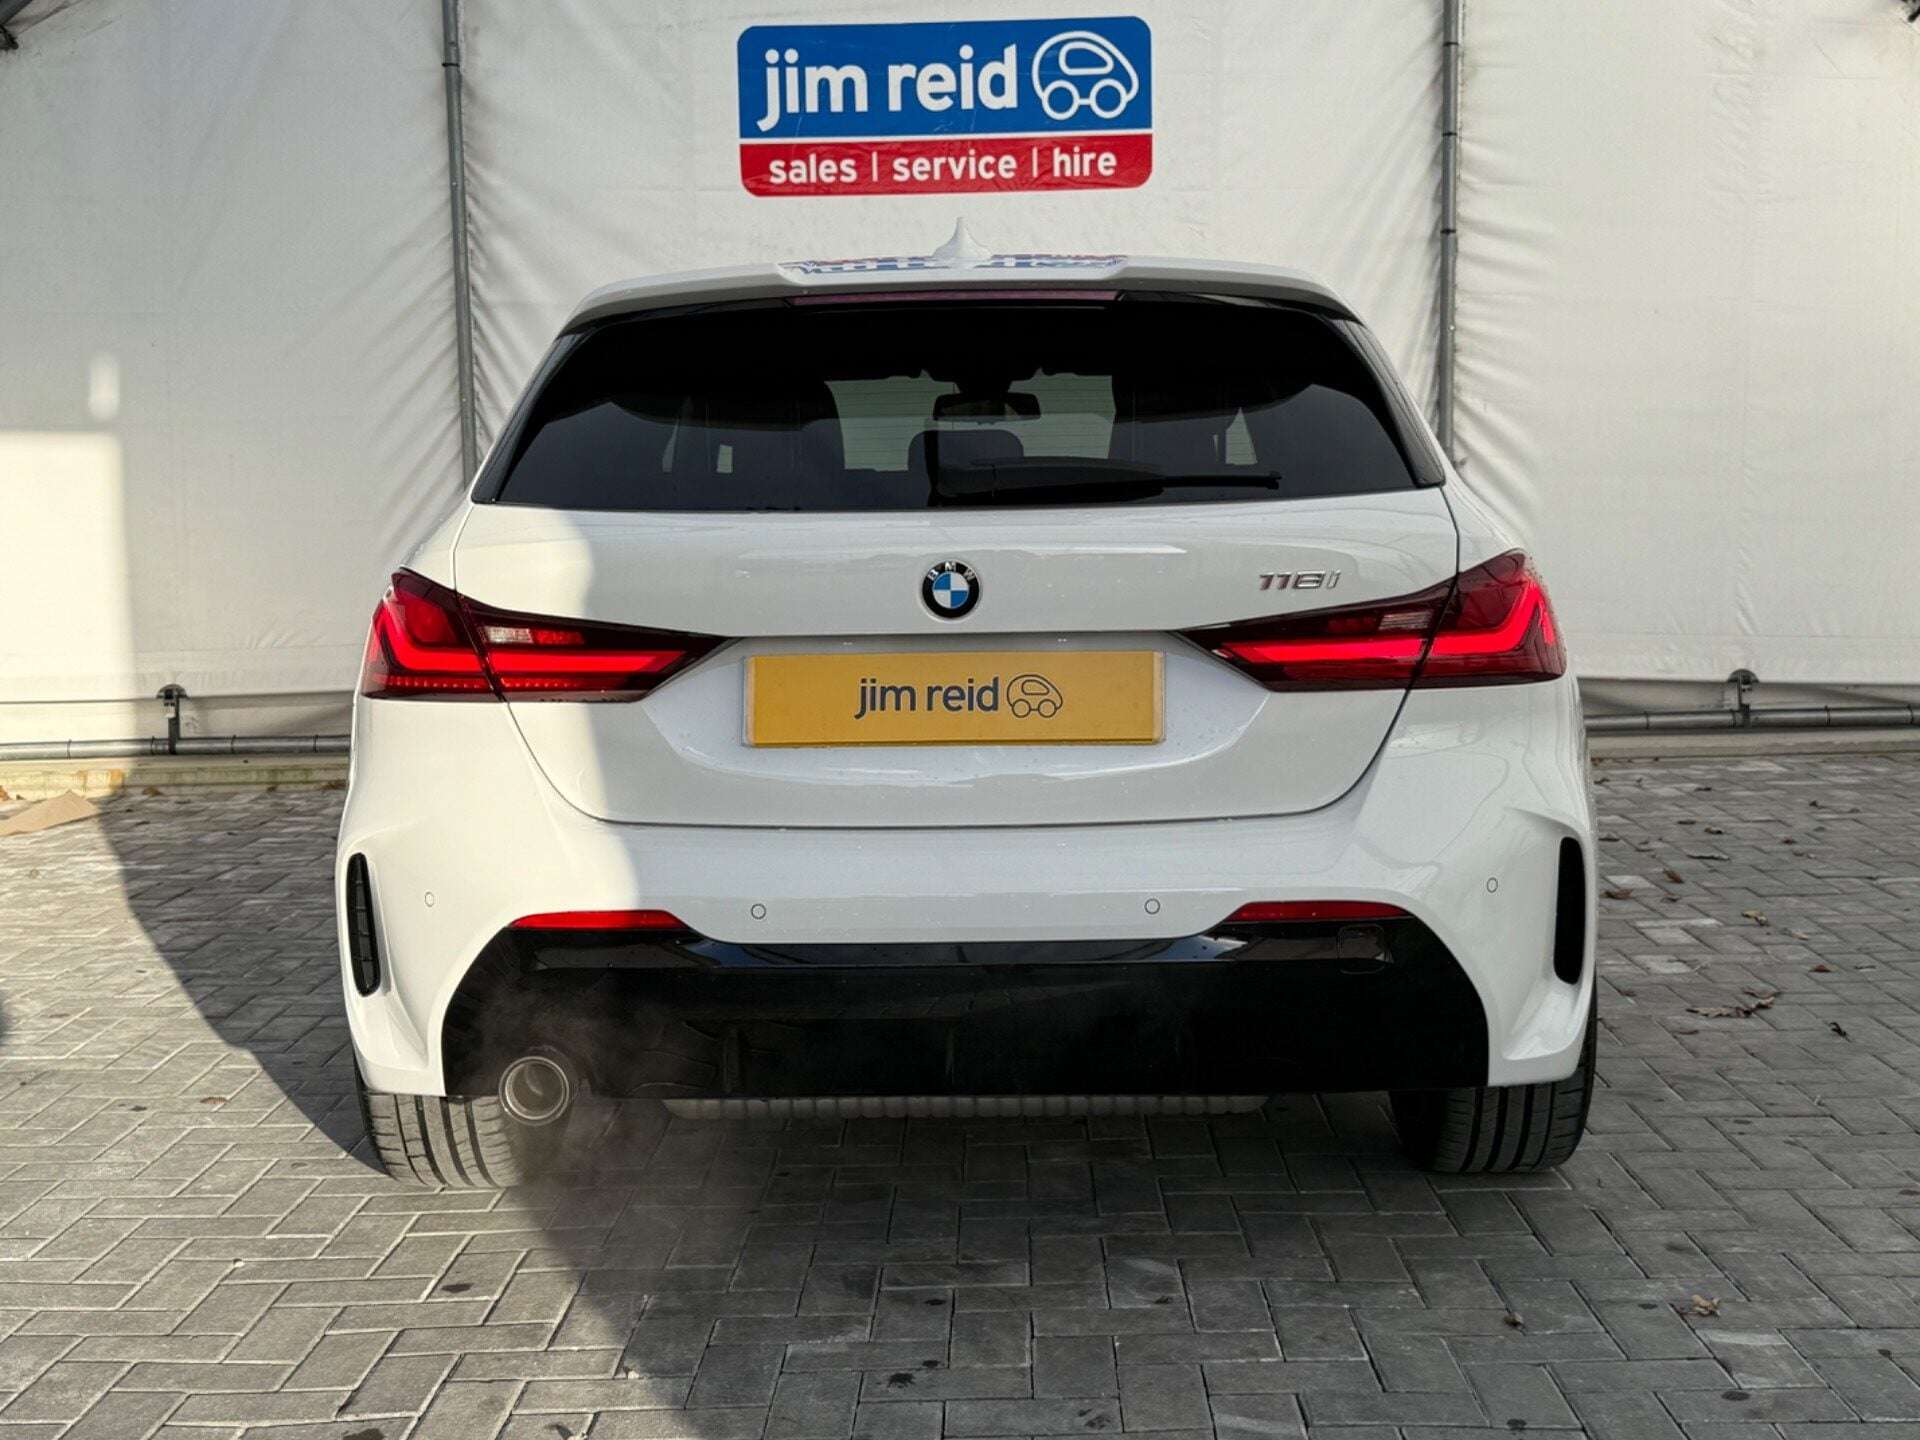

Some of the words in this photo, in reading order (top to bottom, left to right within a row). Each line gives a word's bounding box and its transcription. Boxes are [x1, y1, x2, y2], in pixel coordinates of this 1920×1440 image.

[756, 47, 868, 132] jim
[888, 43, 1018, 111] reid
[768, 153, 857, 184] sales
[892, 150, 1017, 182] service
[1052, 145, 1117, 177] hire
[927, 561, 976, 581] BMW
[1259, 569, 1341, 591] 118i
[854, 678, 916, 719] jim
[927, 676, 999, 712] reid
